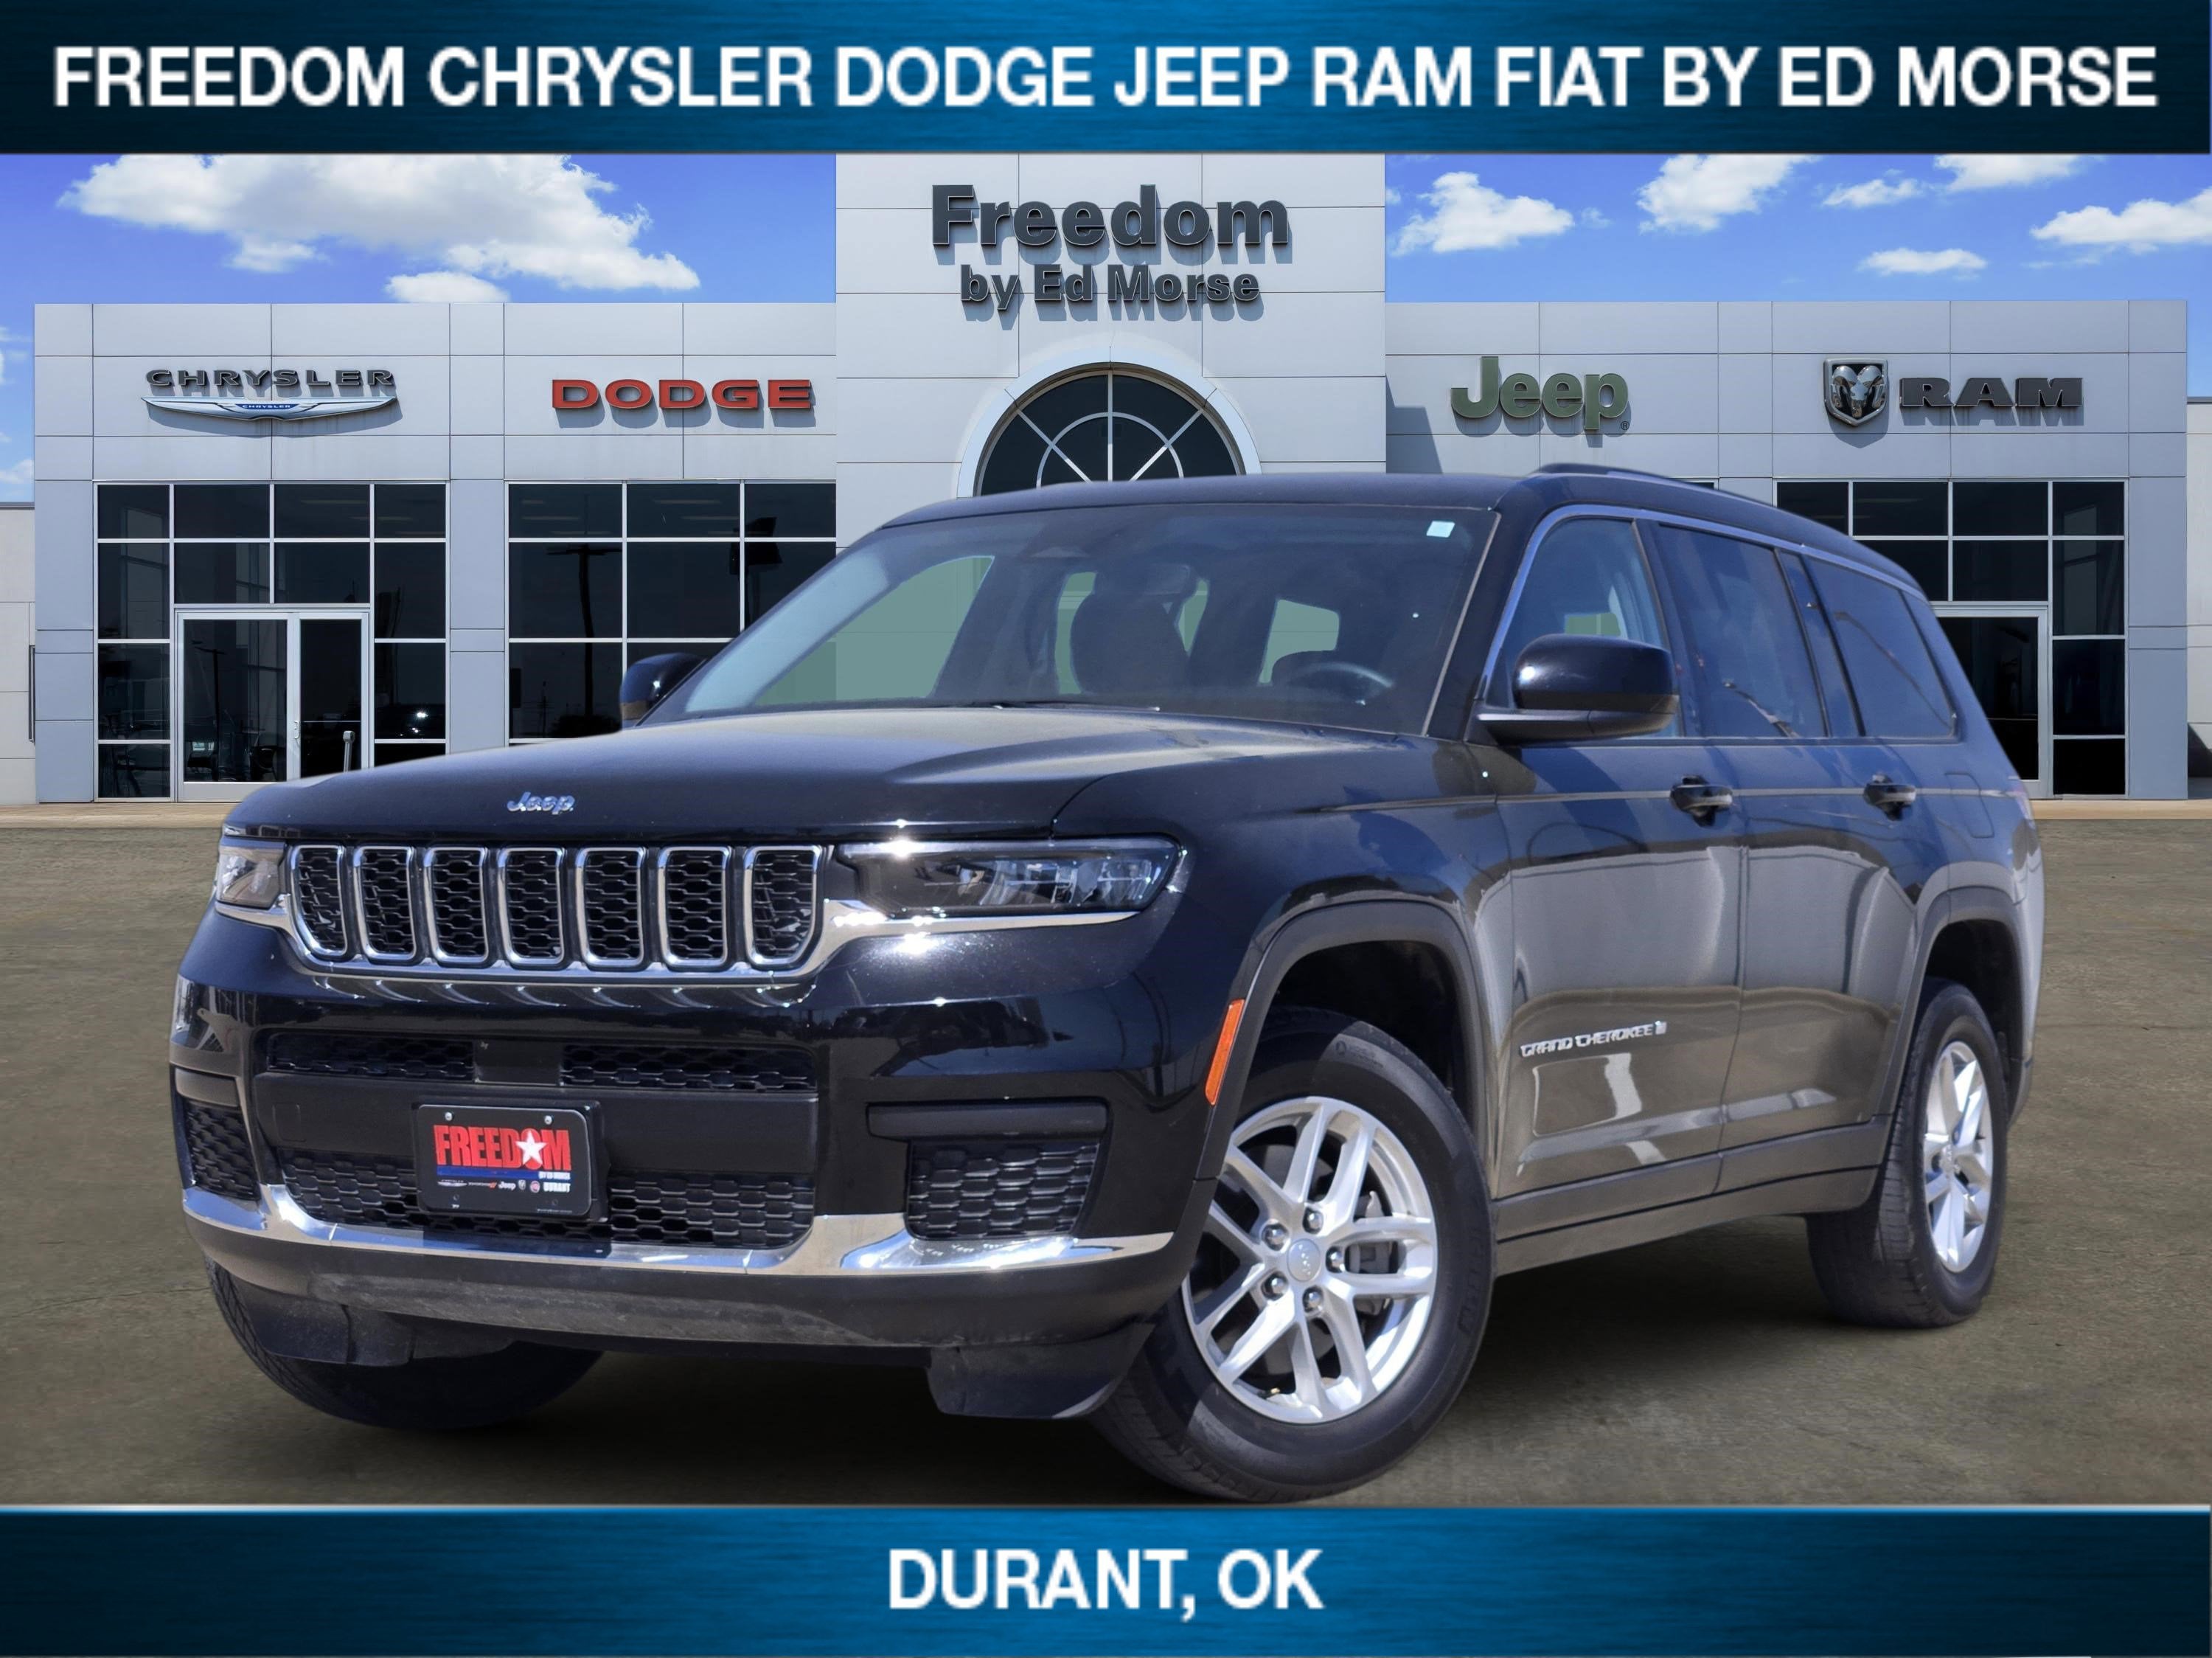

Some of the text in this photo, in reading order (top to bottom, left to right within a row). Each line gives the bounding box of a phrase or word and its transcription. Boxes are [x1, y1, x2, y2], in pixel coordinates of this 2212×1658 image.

[932, 184, 1289, 246] Freedom
[961, 264, 1259, 311] by Ed Morse
[146, 369, 395, 386] CHRYSLER
[552, 379, 810, 409] DODGE
[1450, 356, 1629, 430] Jeep
[1899, 377, 2084, 407] RAM
[507, 791, 575, 815] Jeep
[1520, 1037, 1573, 1057] GRAND
[1575, 1023, 1653, 1047] CHEROKEE
[434, 1125, 571, 1170] FREEDOM
